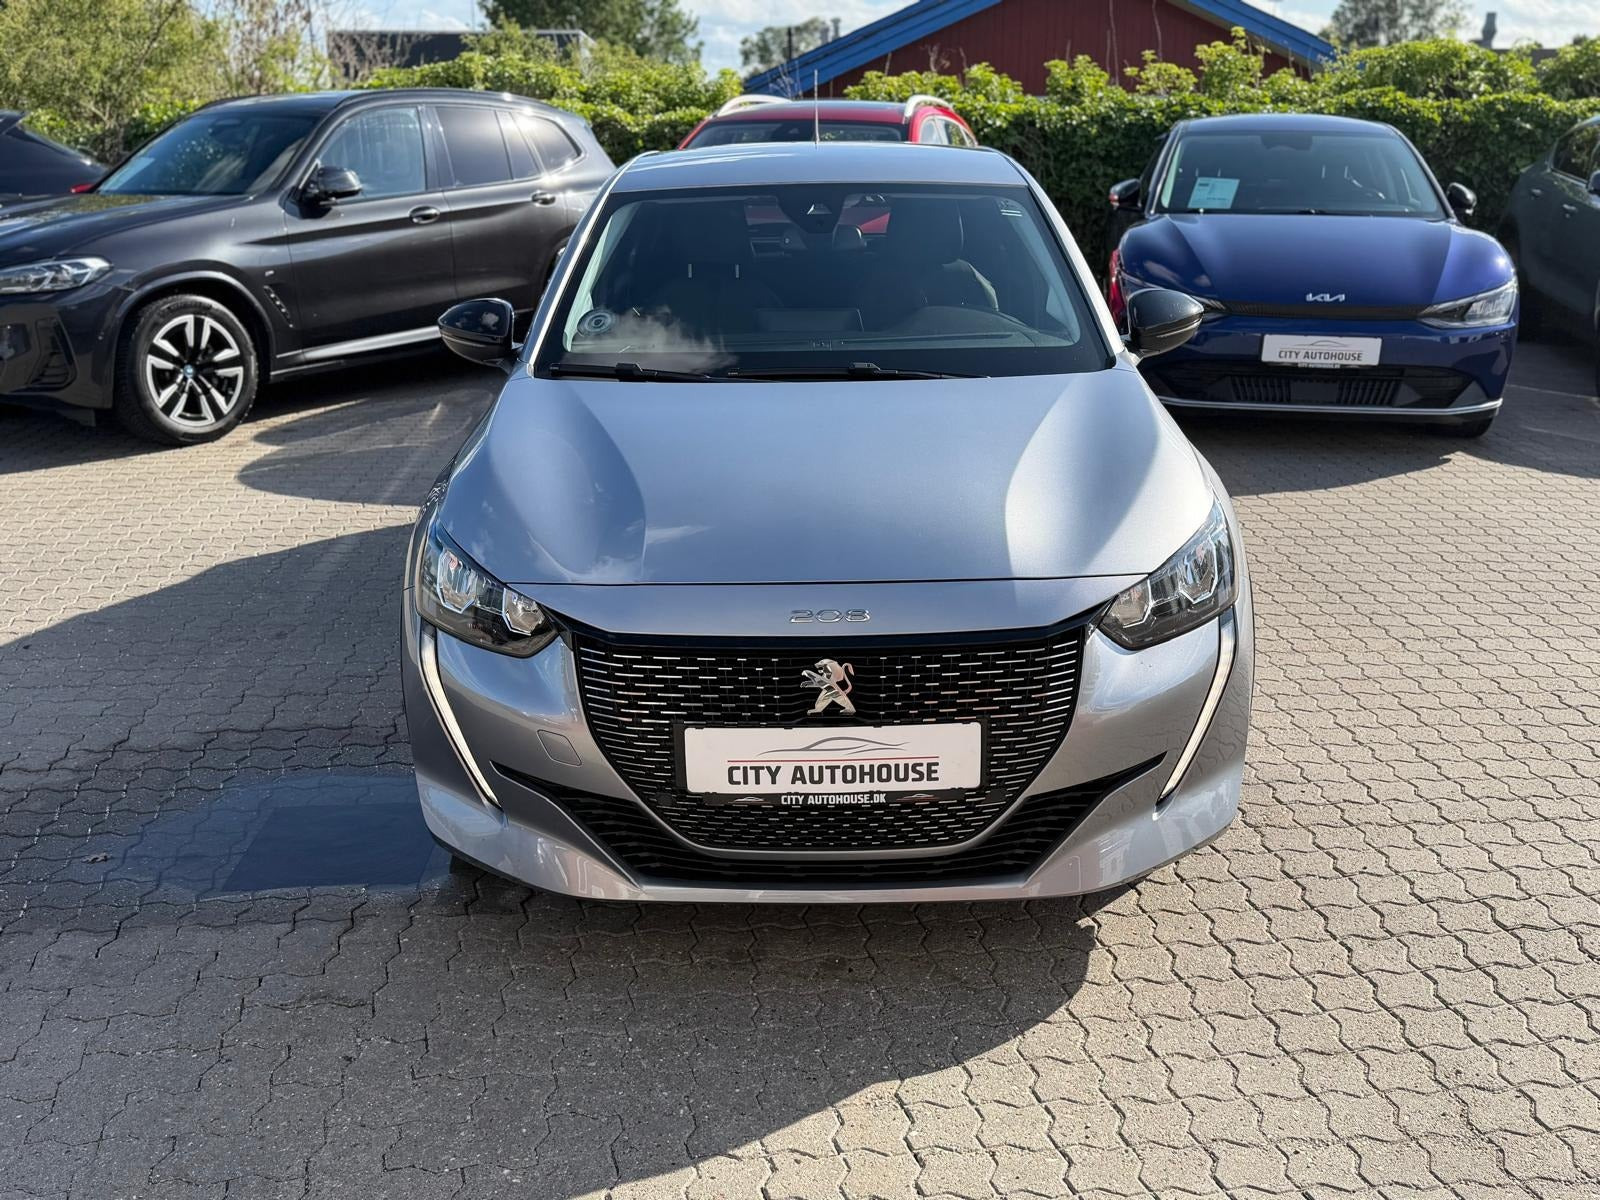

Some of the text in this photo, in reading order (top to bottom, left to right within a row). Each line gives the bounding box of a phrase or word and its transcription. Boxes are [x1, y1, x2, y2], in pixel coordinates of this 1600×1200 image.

[1279, 350, 1363, 361] CITY AUTOHOUSE
[789, 609, 871, 623] 208
[727, 762, 939, 785] CITY AUTOHOUSE
[781, 793, 887, 805] CITY AUTOHOUSE.DK
